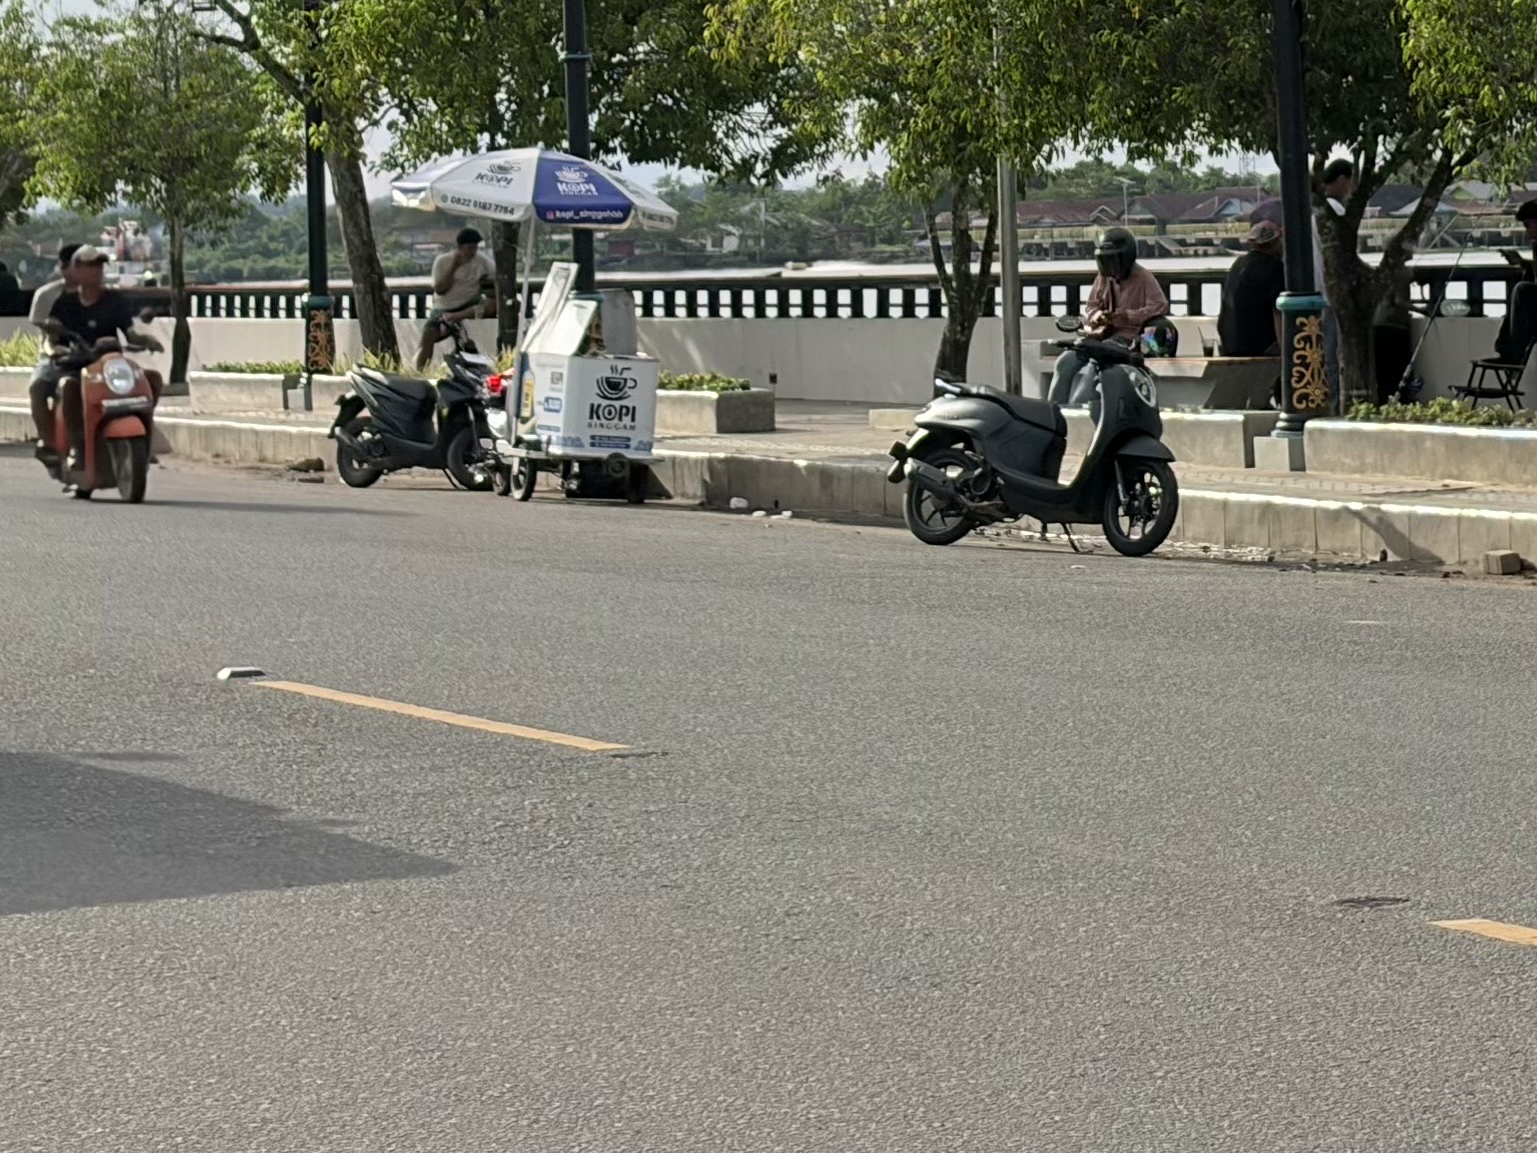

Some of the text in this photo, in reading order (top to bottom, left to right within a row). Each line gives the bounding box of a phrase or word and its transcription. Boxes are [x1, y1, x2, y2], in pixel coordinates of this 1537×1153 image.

[475, 172, 514, 186] KOPI
[556, 182, 597, 193] KOPI
[450, 196, 472, 208] 0822
[588, 403, 637, 423] KOPI
